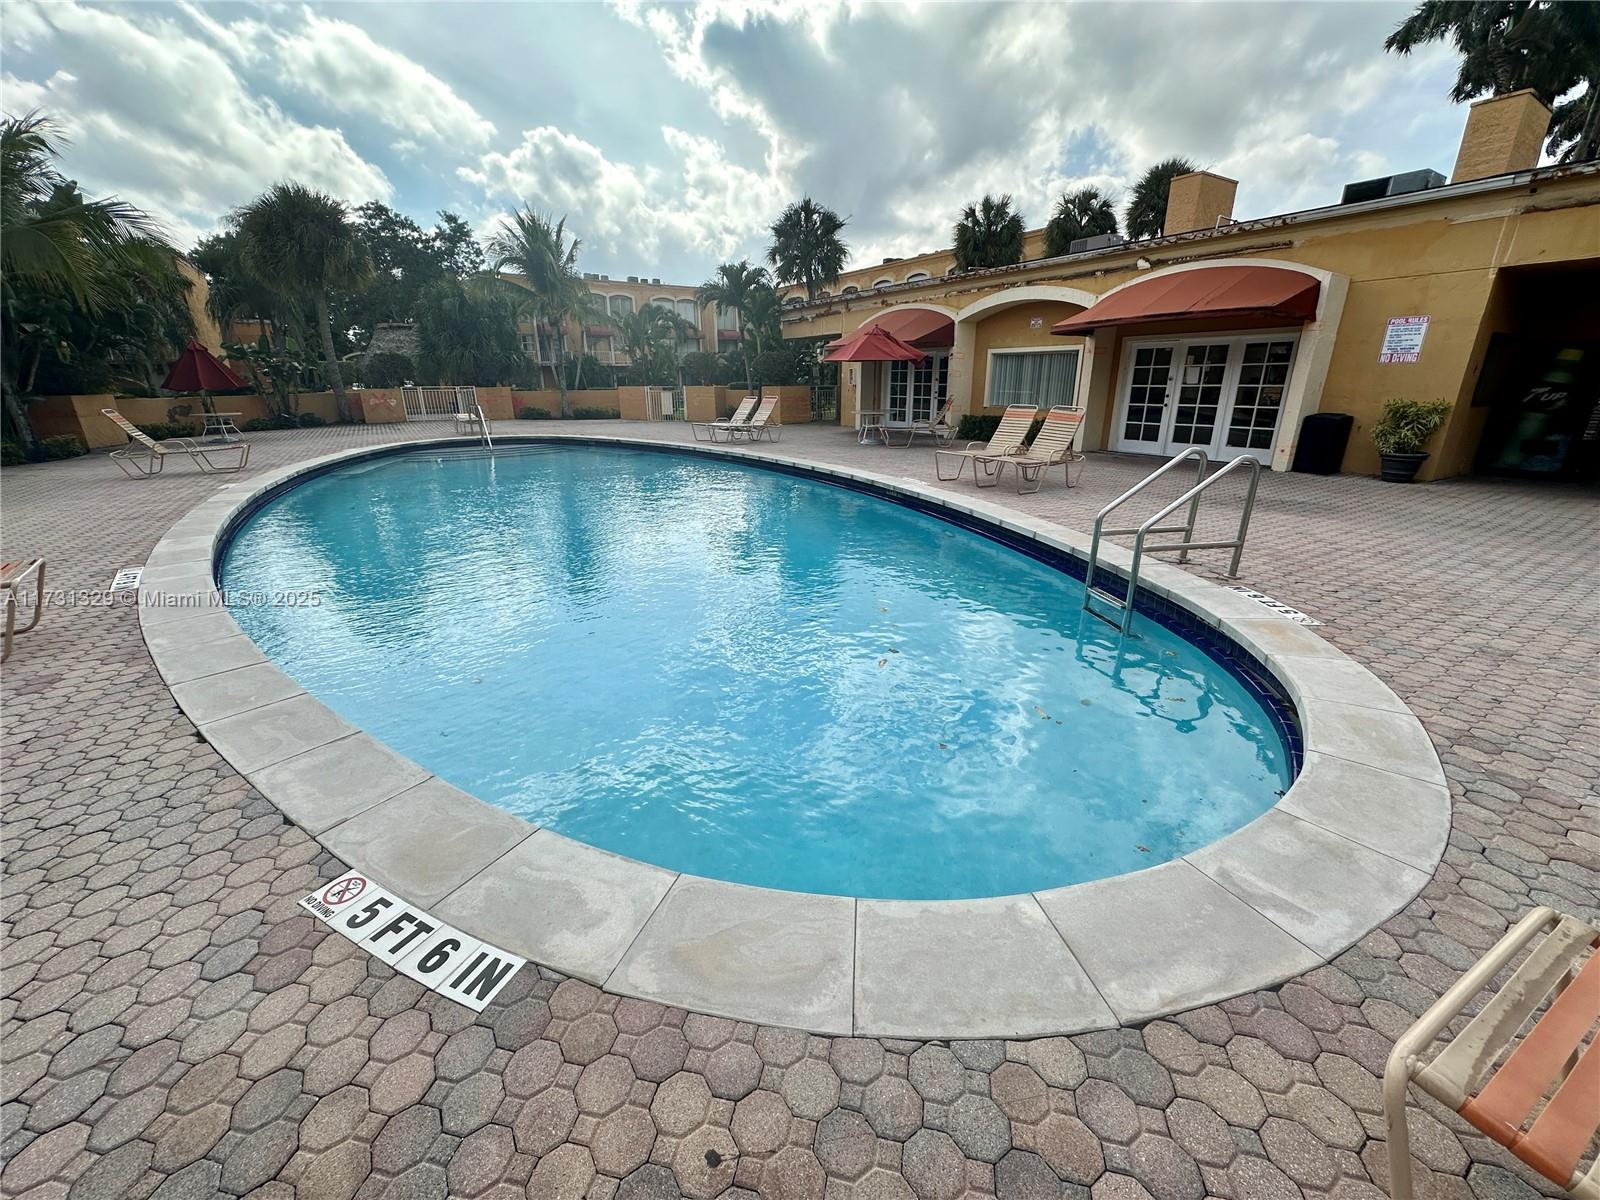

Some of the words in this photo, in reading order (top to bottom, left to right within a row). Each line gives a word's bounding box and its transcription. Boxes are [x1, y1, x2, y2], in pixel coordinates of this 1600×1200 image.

[1380, 353, 1391, 362] NO
[1391, 352, 1418, 362] DIVING
[304, 895, 318, 905] NO
[311, 901, 335, 918] DIVING
[346, 896, 394, 929] 5
[369, 911, 435, 954] FT
[416, 938, 461, 973] 6
[448, 951, 515, 1001] IN
